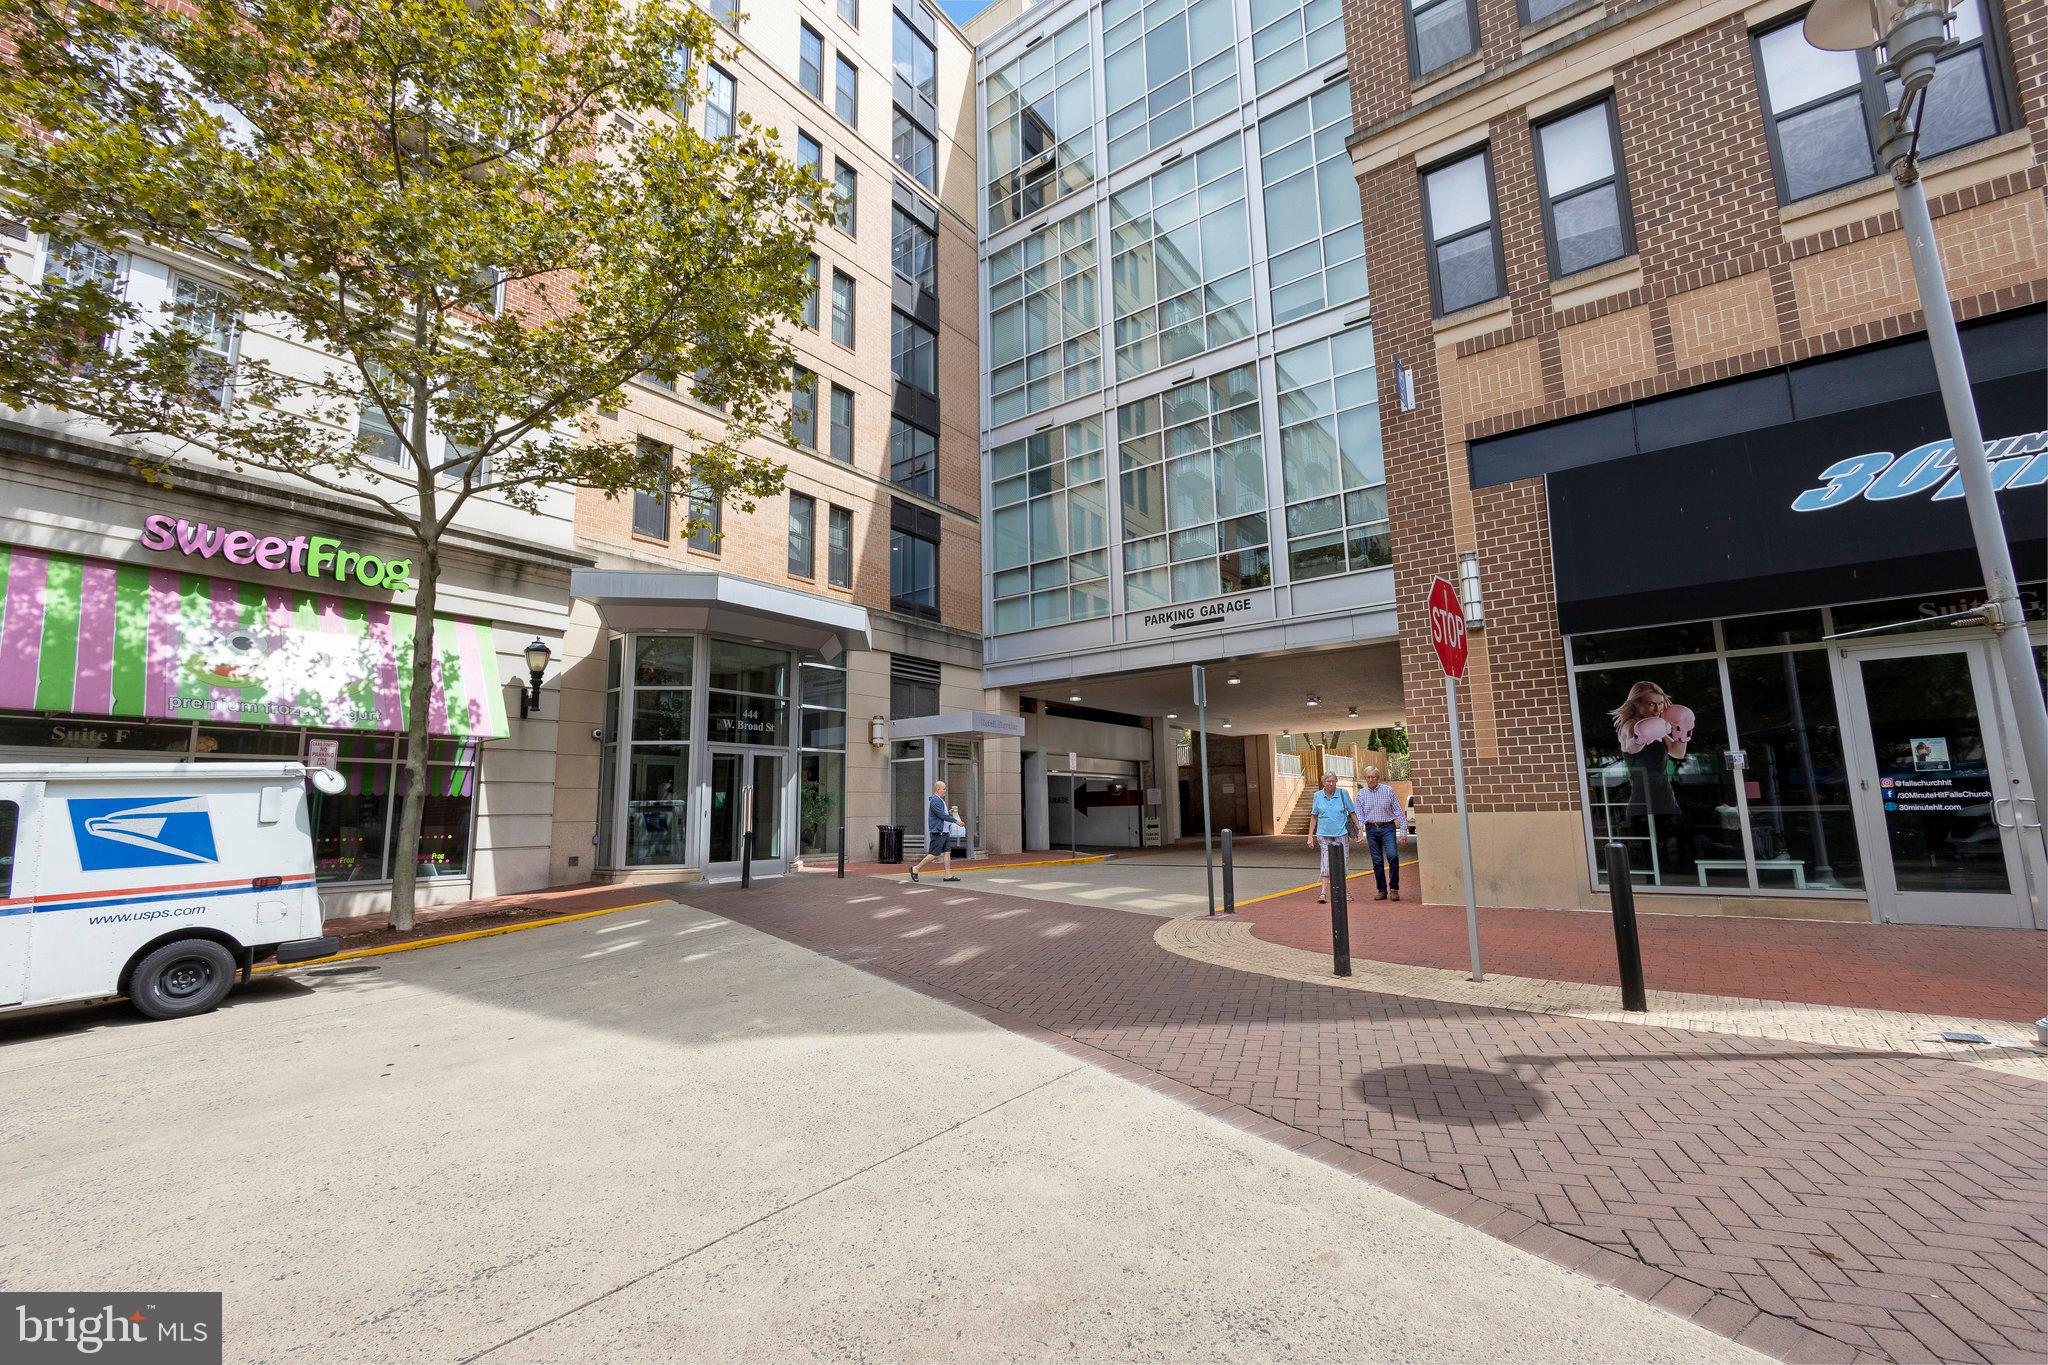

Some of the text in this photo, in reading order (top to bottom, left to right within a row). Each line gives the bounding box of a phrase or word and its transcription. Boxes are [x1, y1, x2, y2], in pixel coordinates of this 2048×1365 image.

[1791, 438, 1961, 512] 30
[140, 513, 412, 592] sweetFrog
[1144, 598, 1251, 626] PARKING GARAGE
[1432, 606, 1464, 649] STOP
[168, 694, 258, 713] premium
[742, 709, 758, 719] 444
[722, 718, 735, 729] W.
[737, 720, 764, 731] Broad
[51, 726, 131, 743] Suite F
[1898, 803, 1962, 811] 30minutehit.com
[89, 905, 206, 925] www.usps.com
